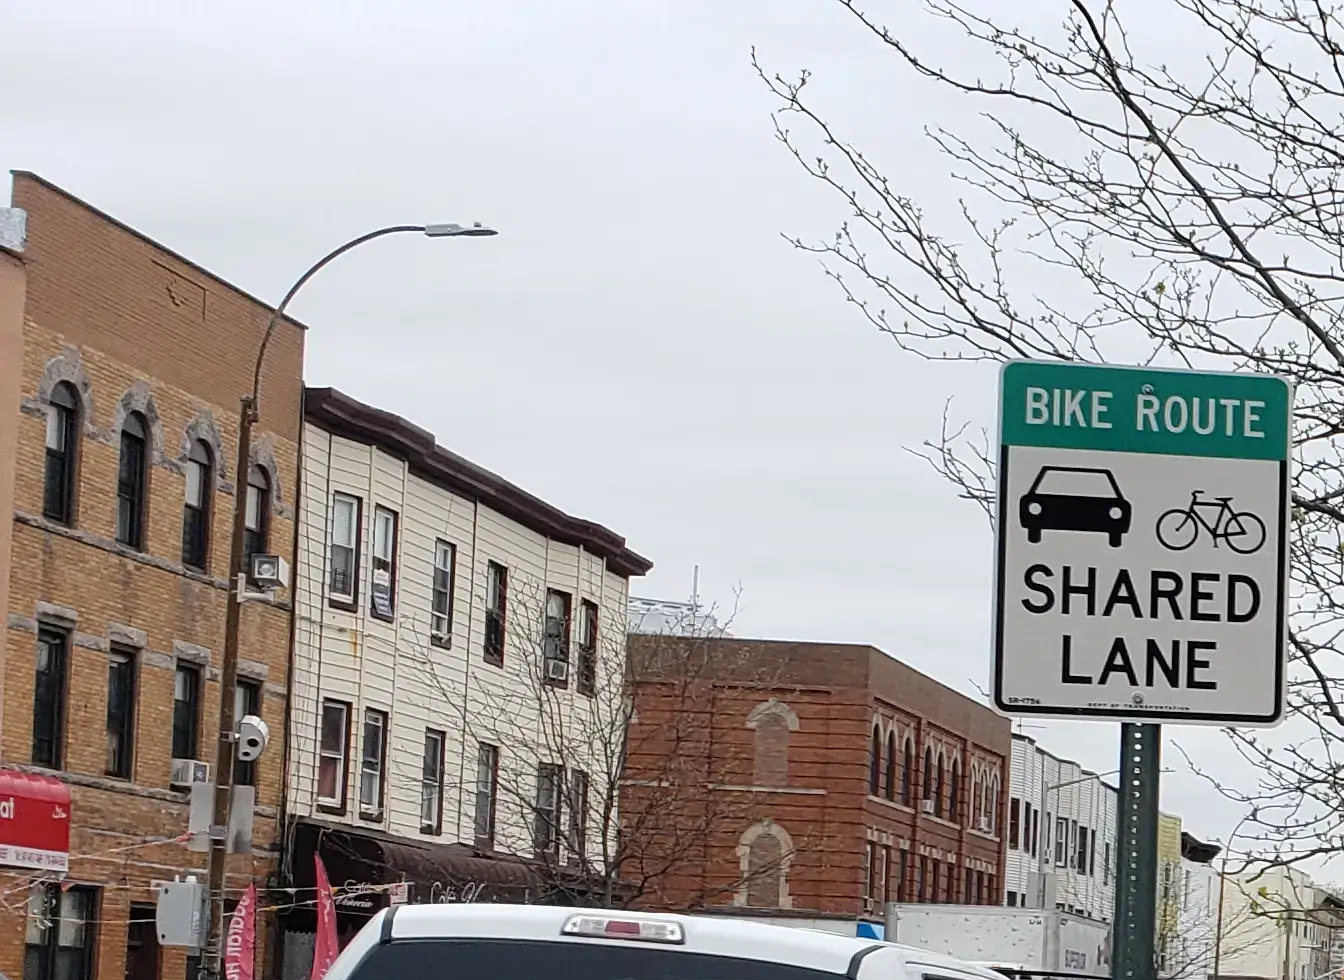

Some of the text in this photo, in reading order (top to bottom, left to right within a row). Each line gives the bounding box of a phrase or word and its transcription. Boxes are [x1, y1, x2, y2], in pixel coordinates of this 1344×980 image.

[1025, 386, 1265, 438] BIKE ROUTE
[1021, 563, 1261, 623] SHARED
[1061, 634, 1218, 690] LANE
